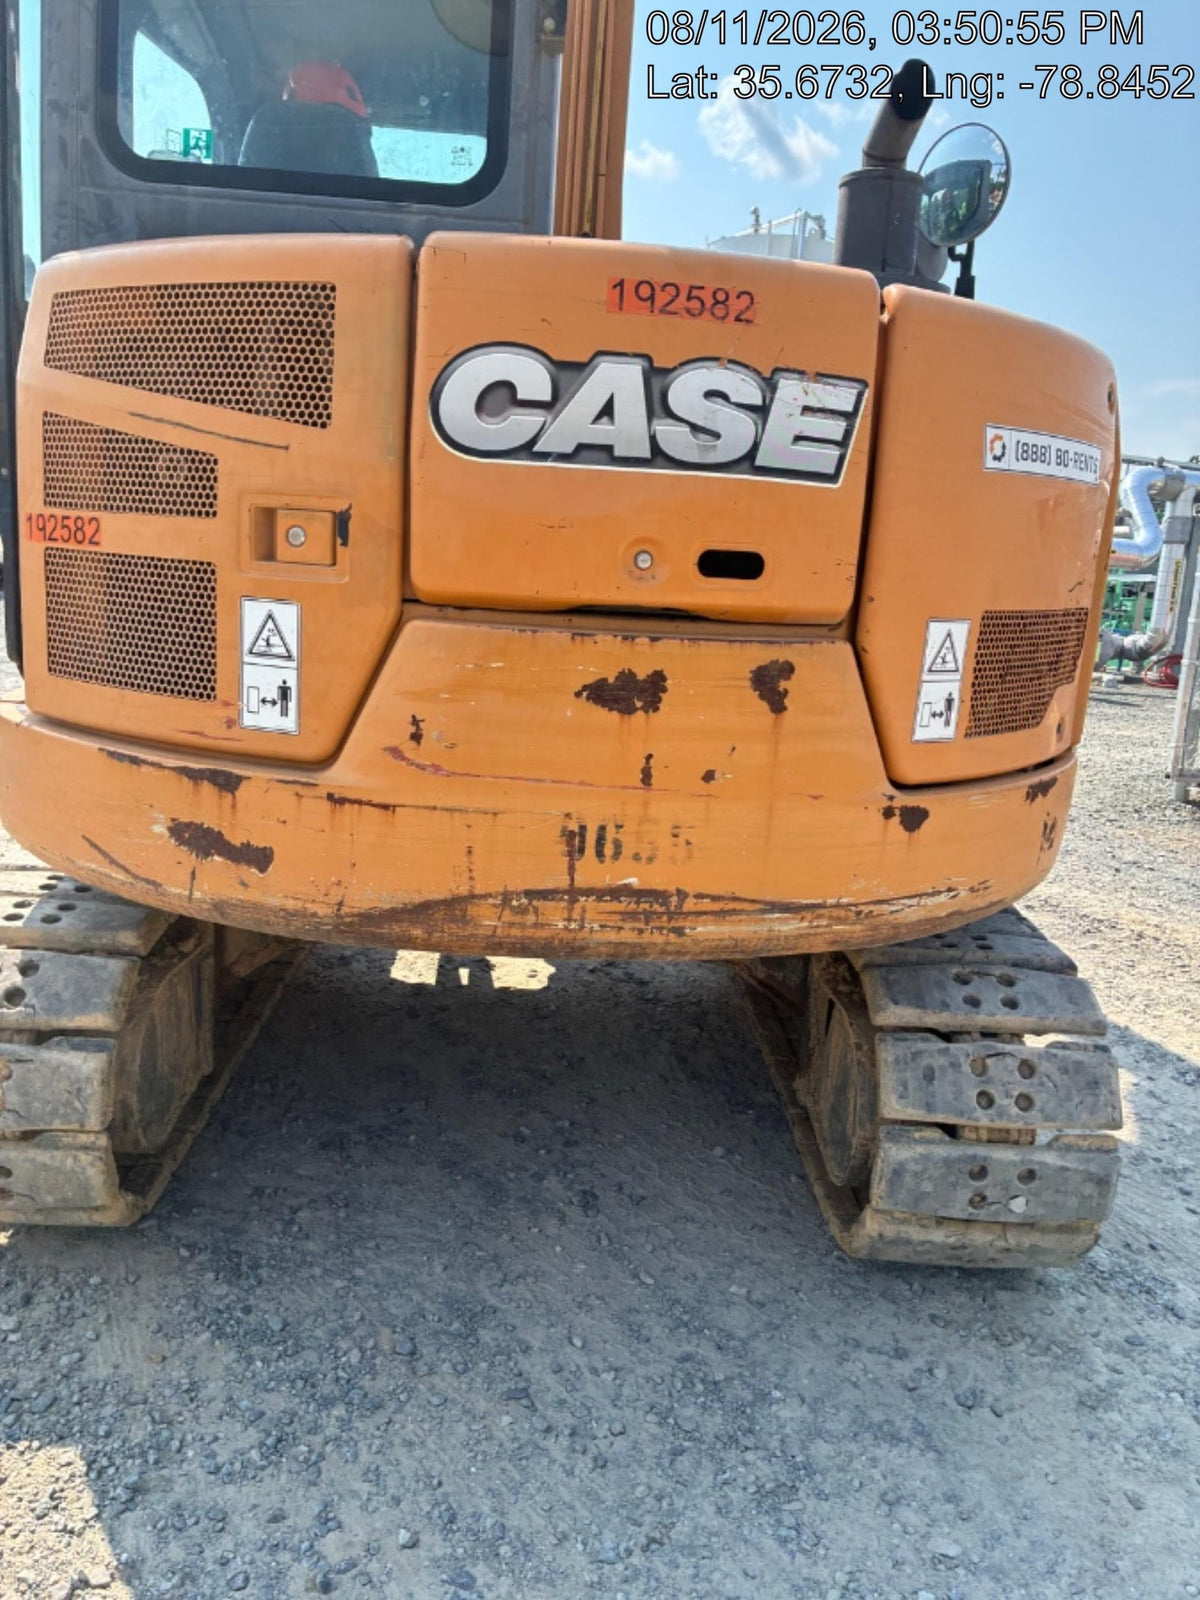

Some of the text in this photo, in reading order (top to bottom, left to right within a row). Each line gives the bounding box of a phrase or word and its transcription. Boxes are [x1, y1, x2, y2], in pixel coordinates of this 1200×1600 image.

[610, 278, 755, 325] 192582
[438, 352, 860, 476] CASE
[1015, 440, 1052, 466] (888)
[25, 512, 100, 546] 192582
